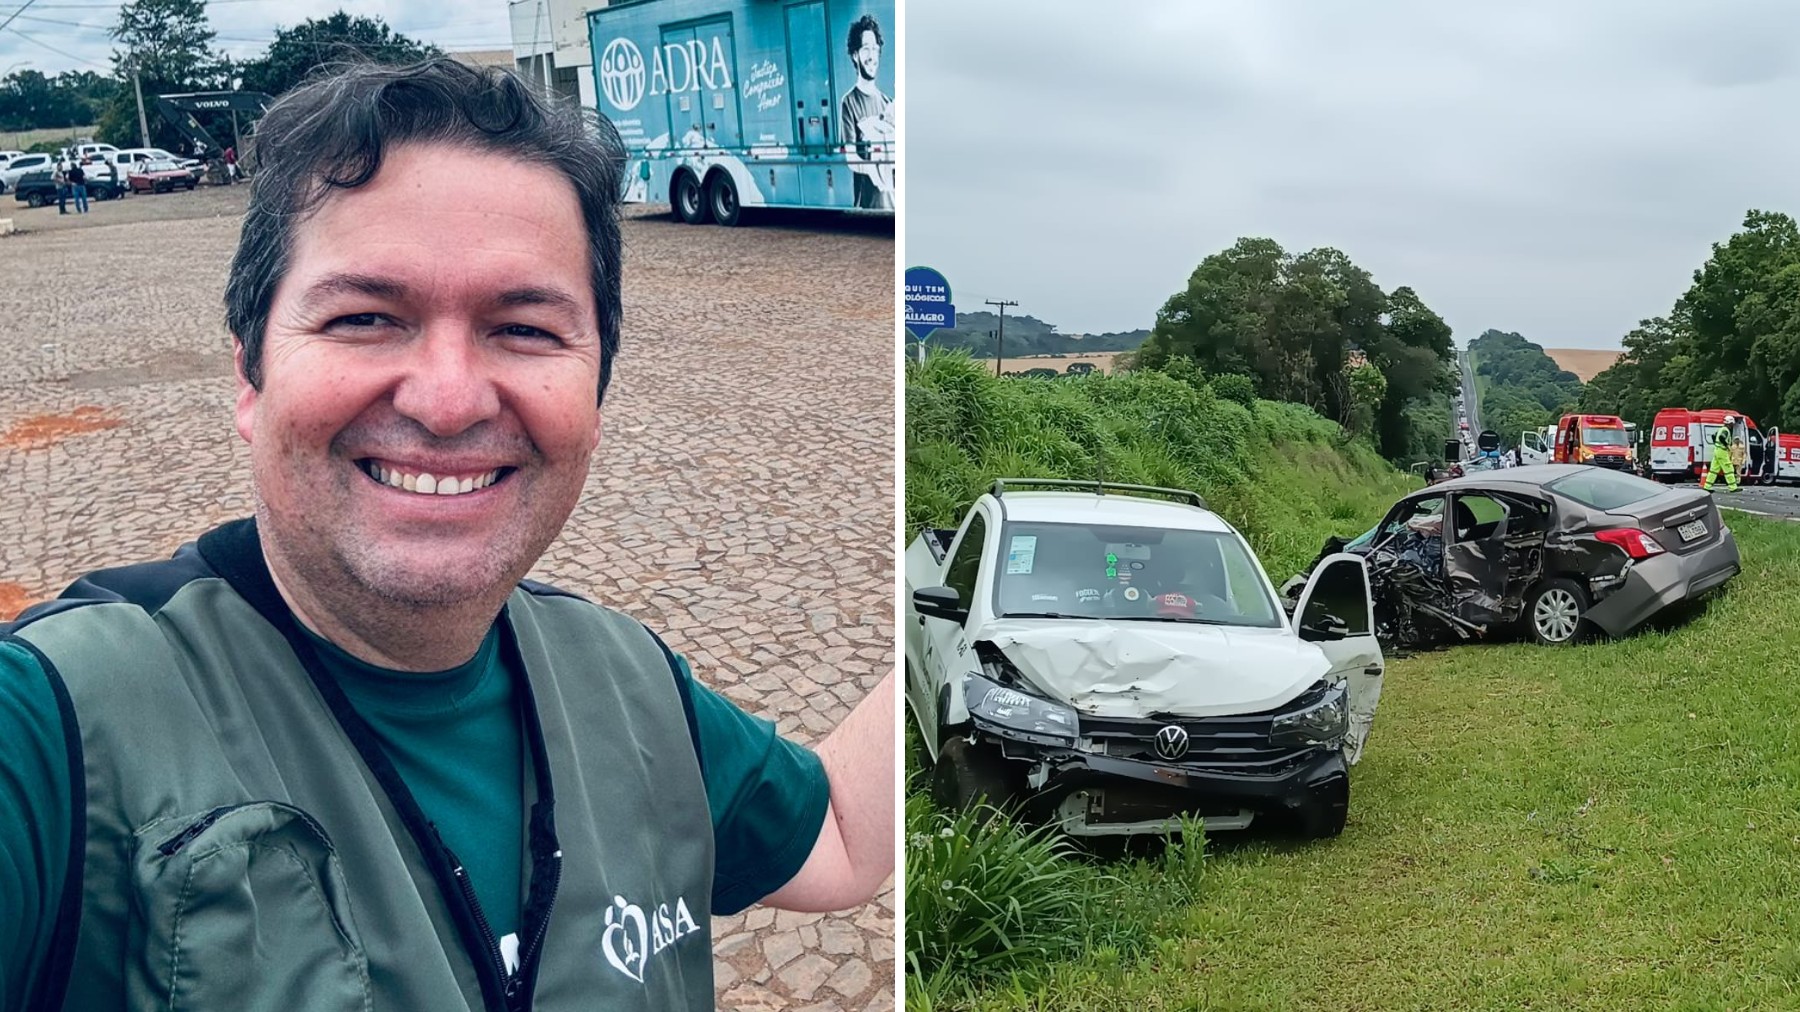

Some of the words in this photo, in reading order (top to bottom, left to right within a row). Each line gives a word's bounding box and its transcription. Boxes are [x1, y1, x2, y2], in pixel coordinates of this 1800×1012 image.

[649, 36, 732, 96] ADRA
[195, 100, 229, 108] VOLVO
[757, 92, 781, 112] Amor
[925, 285, 945, 293] TEM
[652, 896, 701, 955] ASA
